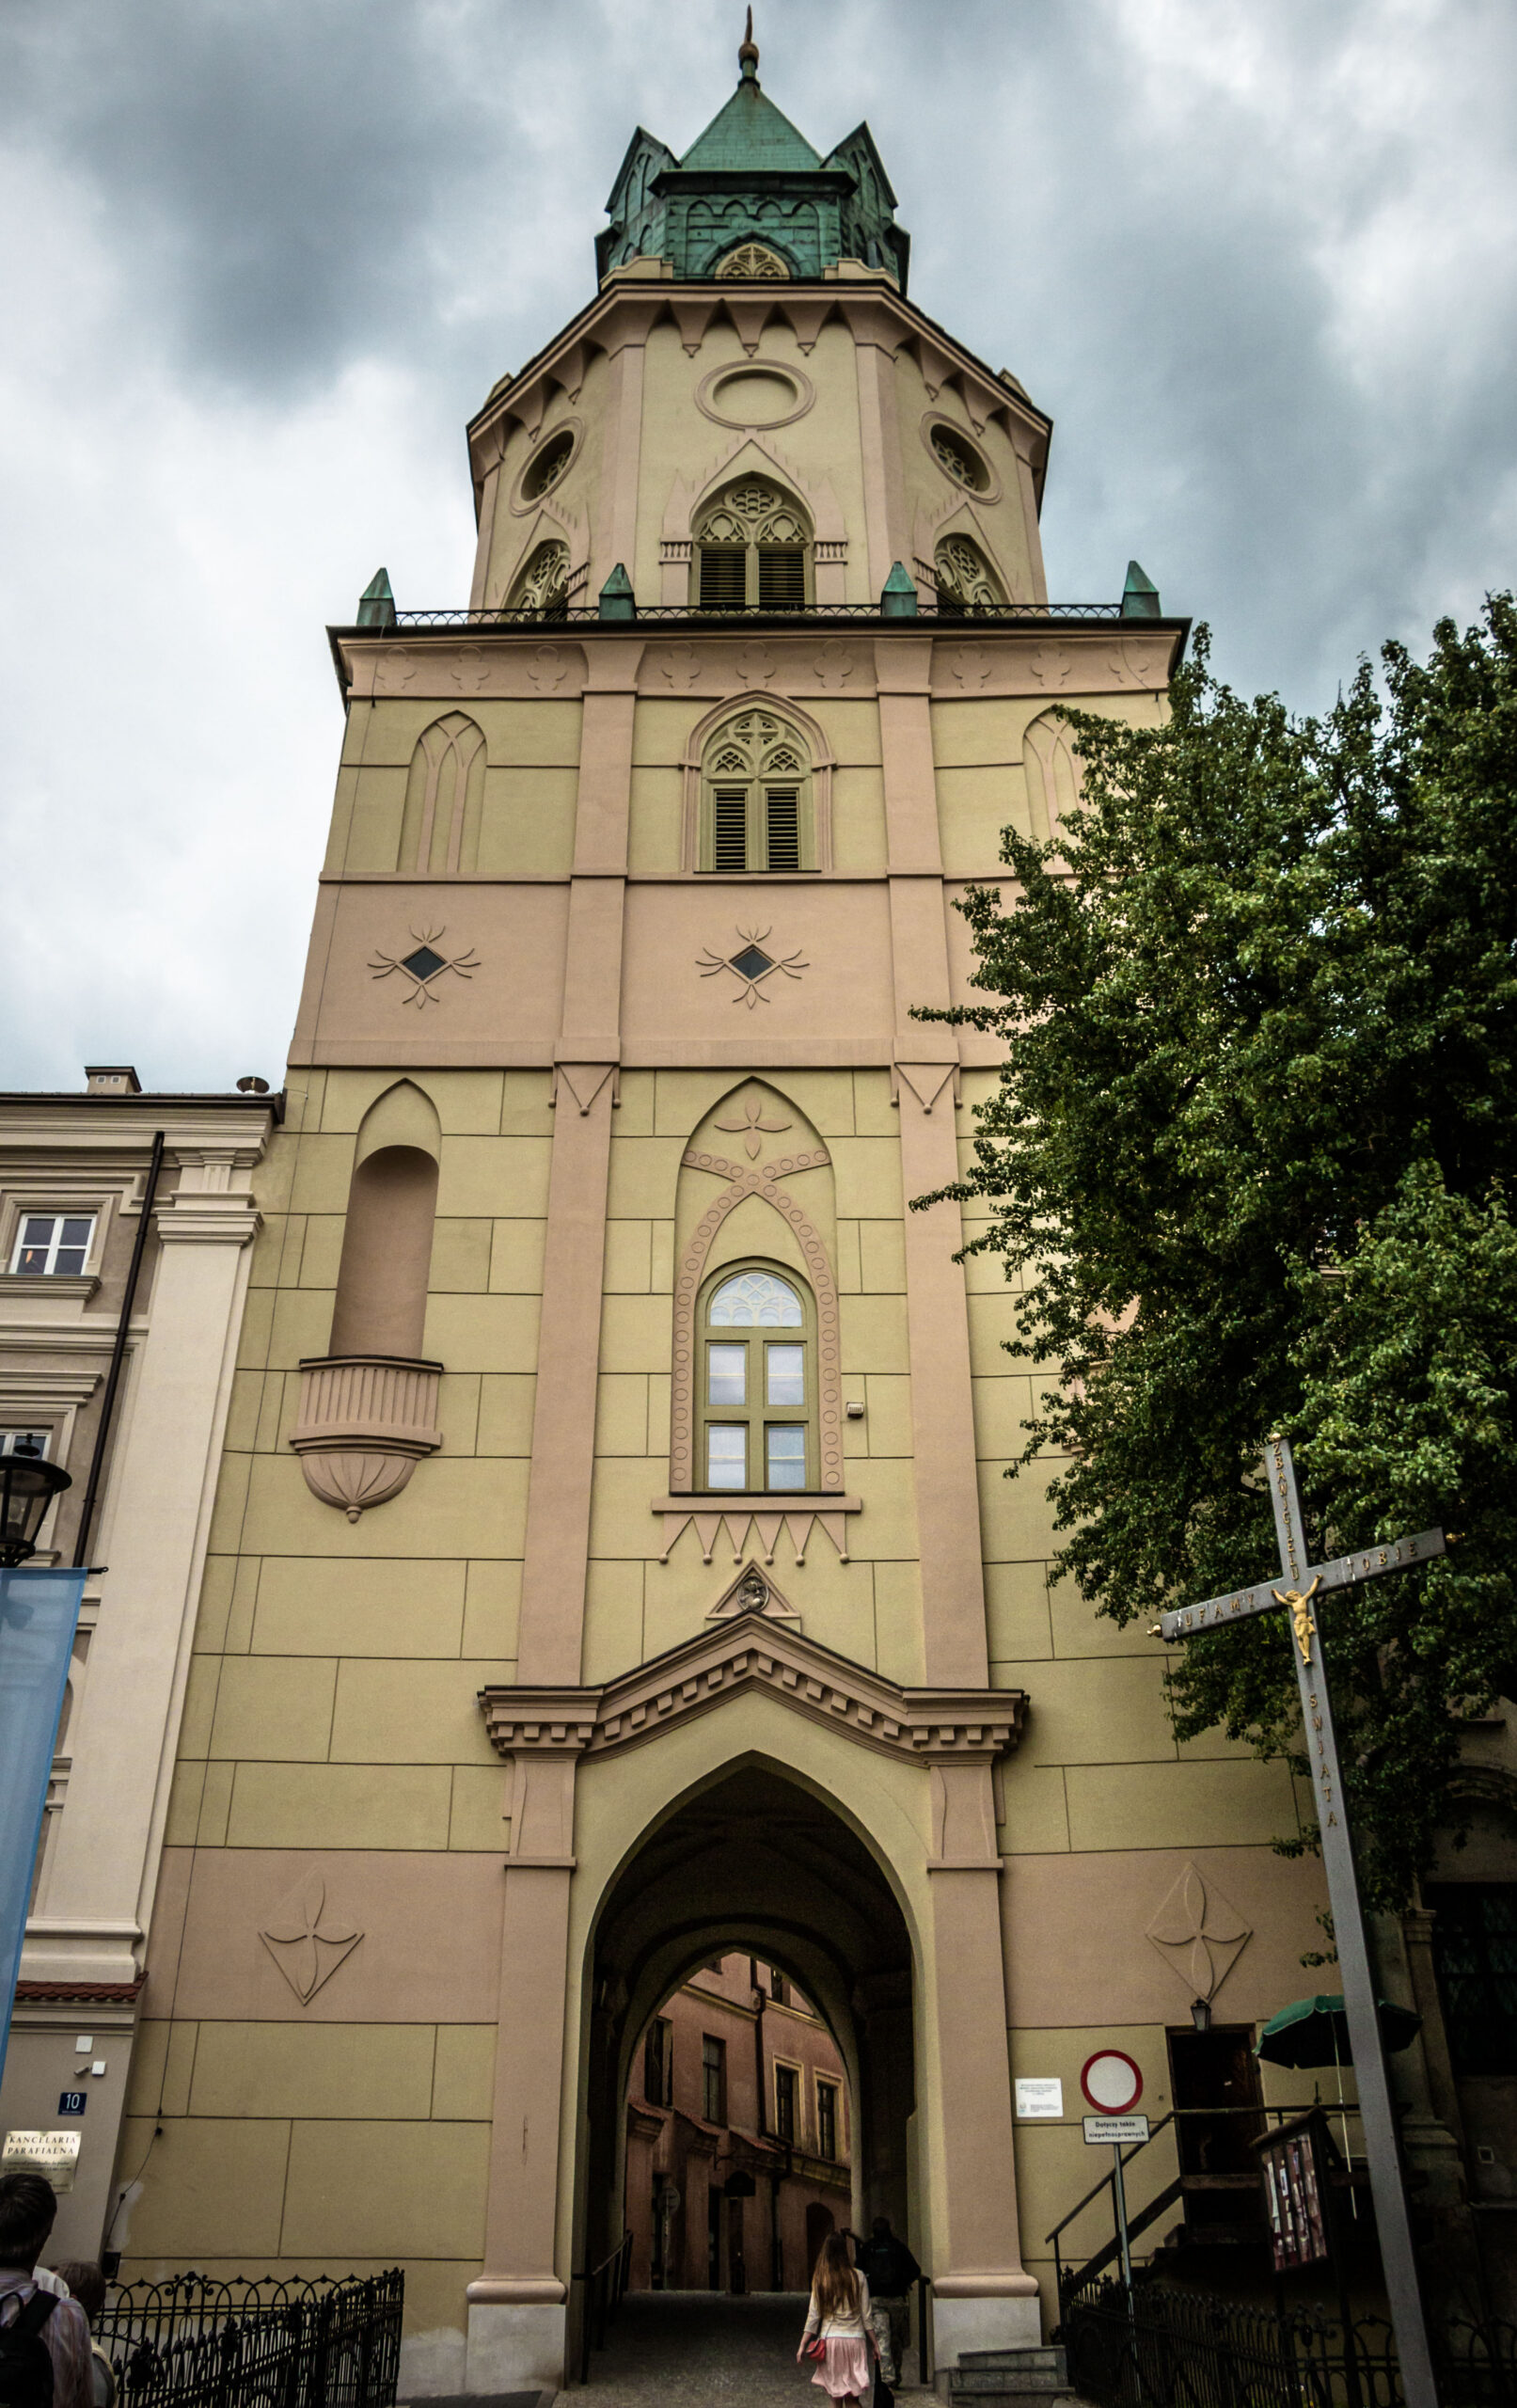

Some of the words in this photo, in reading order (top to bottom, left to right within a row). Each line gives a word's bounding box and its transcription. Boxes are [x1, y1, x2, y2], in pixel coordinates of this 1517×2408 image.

[1272, 1442, 1300, 1580] ZBAWICIELU
[1185, 1592, 1255, 1627] UFAMY
[66, 2093, 80, 2110] 10
